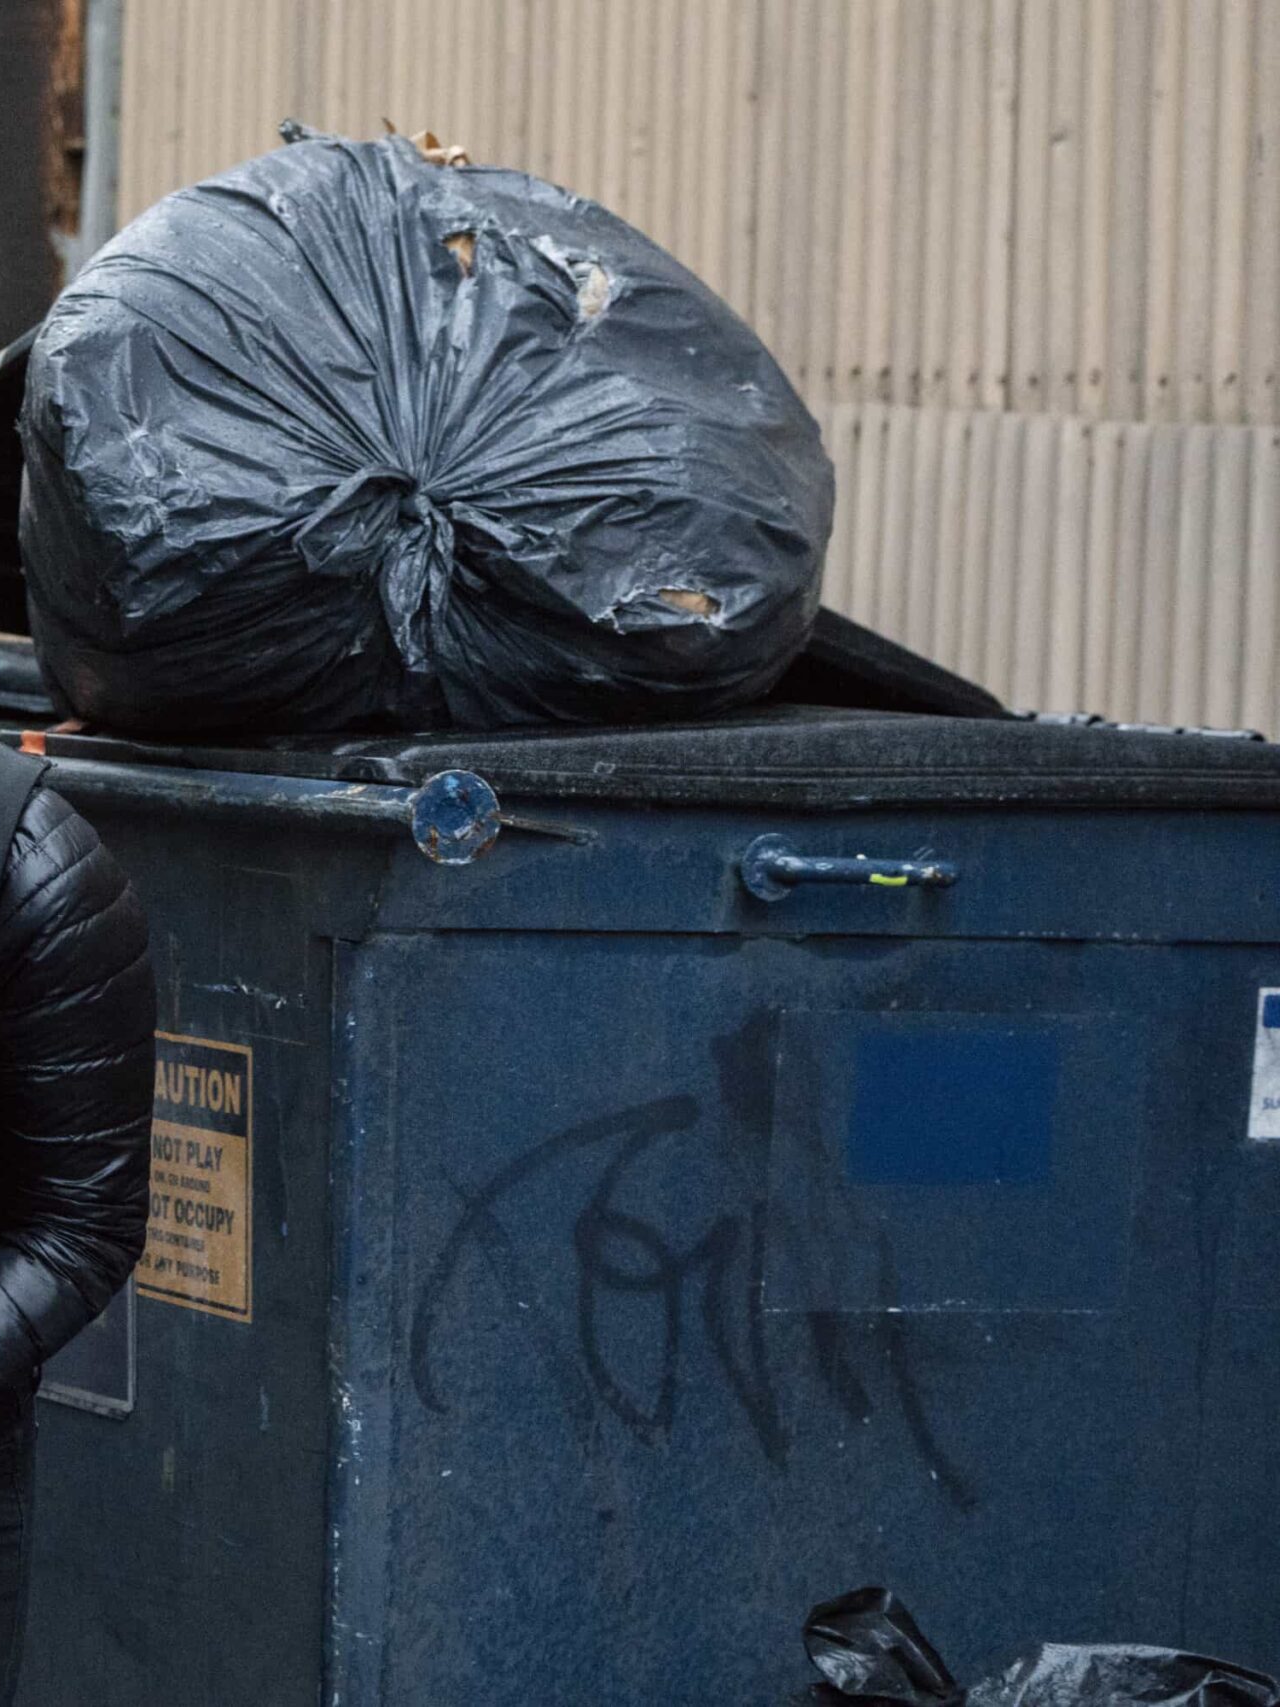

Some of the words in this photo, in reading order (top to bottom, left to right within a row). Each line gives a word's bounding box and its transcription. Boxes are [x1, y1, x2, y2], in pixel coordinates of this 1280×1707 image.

[154, 1060, 241, 1116] AUTION
[152, 1134, 182, 1163] NOT
[186, 1141, 224, 1172] PLAY
[151, 1192, 170, 1219] OT
[174, 1198, 235, 1235] OCCUPY
[176, 1260, 220, 1285] PURPOSE
